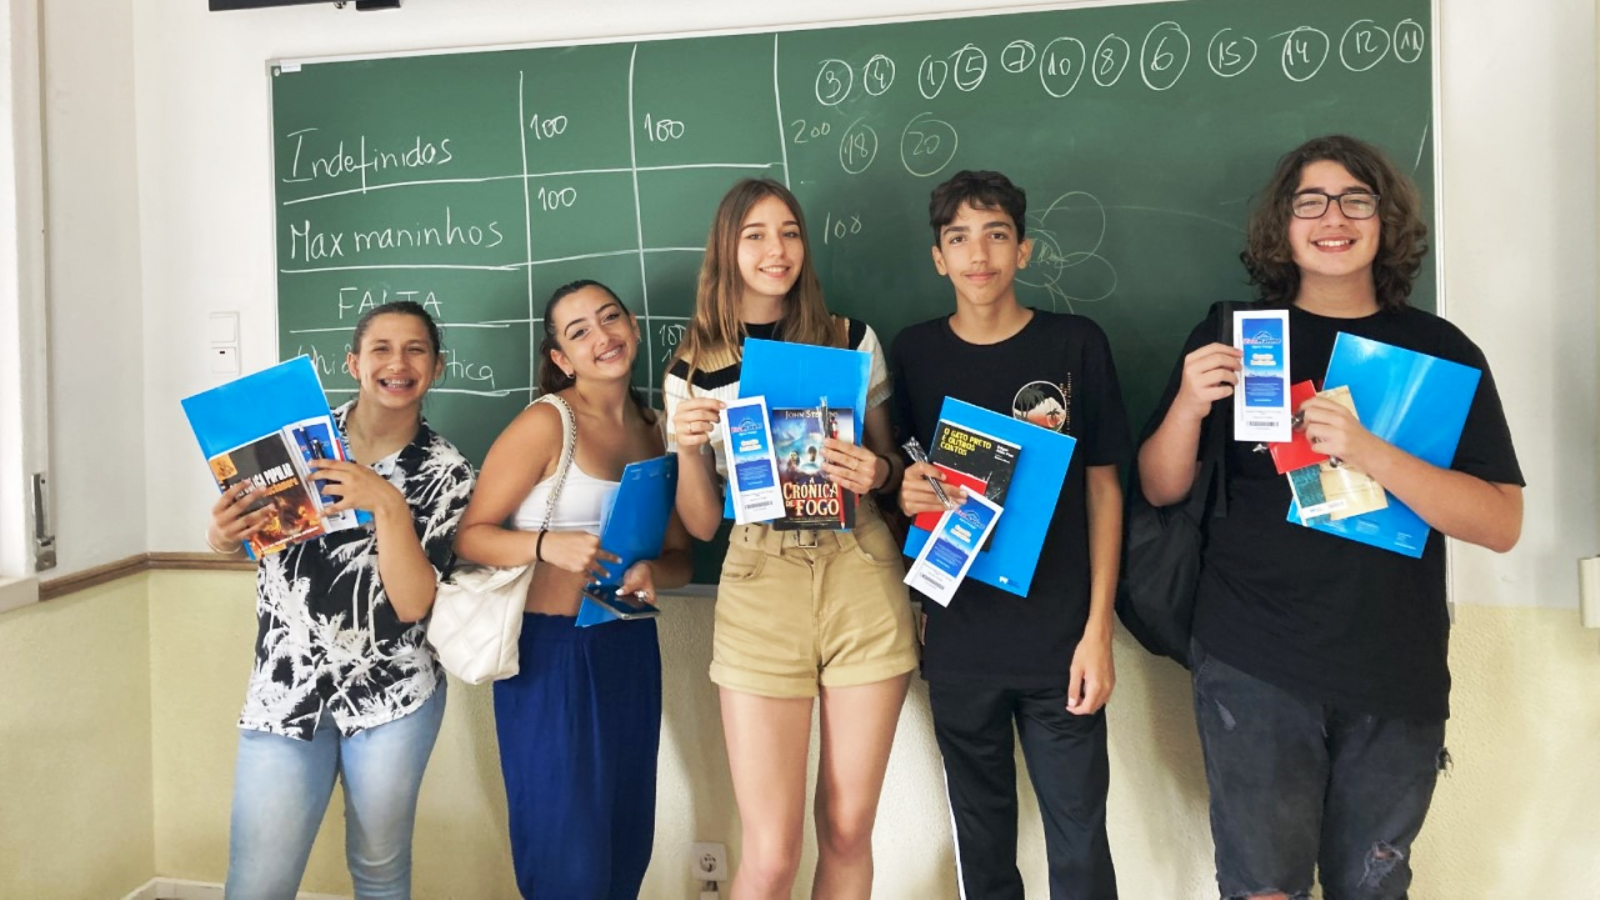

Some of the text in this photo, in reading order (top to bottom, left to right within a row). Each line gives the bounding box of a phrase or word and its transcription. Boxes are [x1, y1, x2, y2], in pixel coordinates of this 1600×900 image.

[960, 55, 983, 86] 5
[1008, 44, 1026, 72] 7
[1048, 52, 1071, 76] 10
[1150, 37, 1174, 72] 6
[1218, 41, 1242, 69] 15
[1286, 38, 1311, 66] 14
[1355, 30, 1379, 54] 12
[1400, 30, 1422, 51] 11
[530, 113, 568, 140] 100
[644, 112, 685, 142] 100
[791, 119, 941, 165] 200 18 20
[538, 186, 577, 212] 100
[290, 205, 504, 262] Max maninhos
[940, 441, 967, 457] CONTOS
[944, 427, 992, 450] O GATO PRETO
[947, 436, 976, 452] OUTROS
[783, 480, 839, 501] CRÓNICA
[796, 498, 840, 517] FOGO
